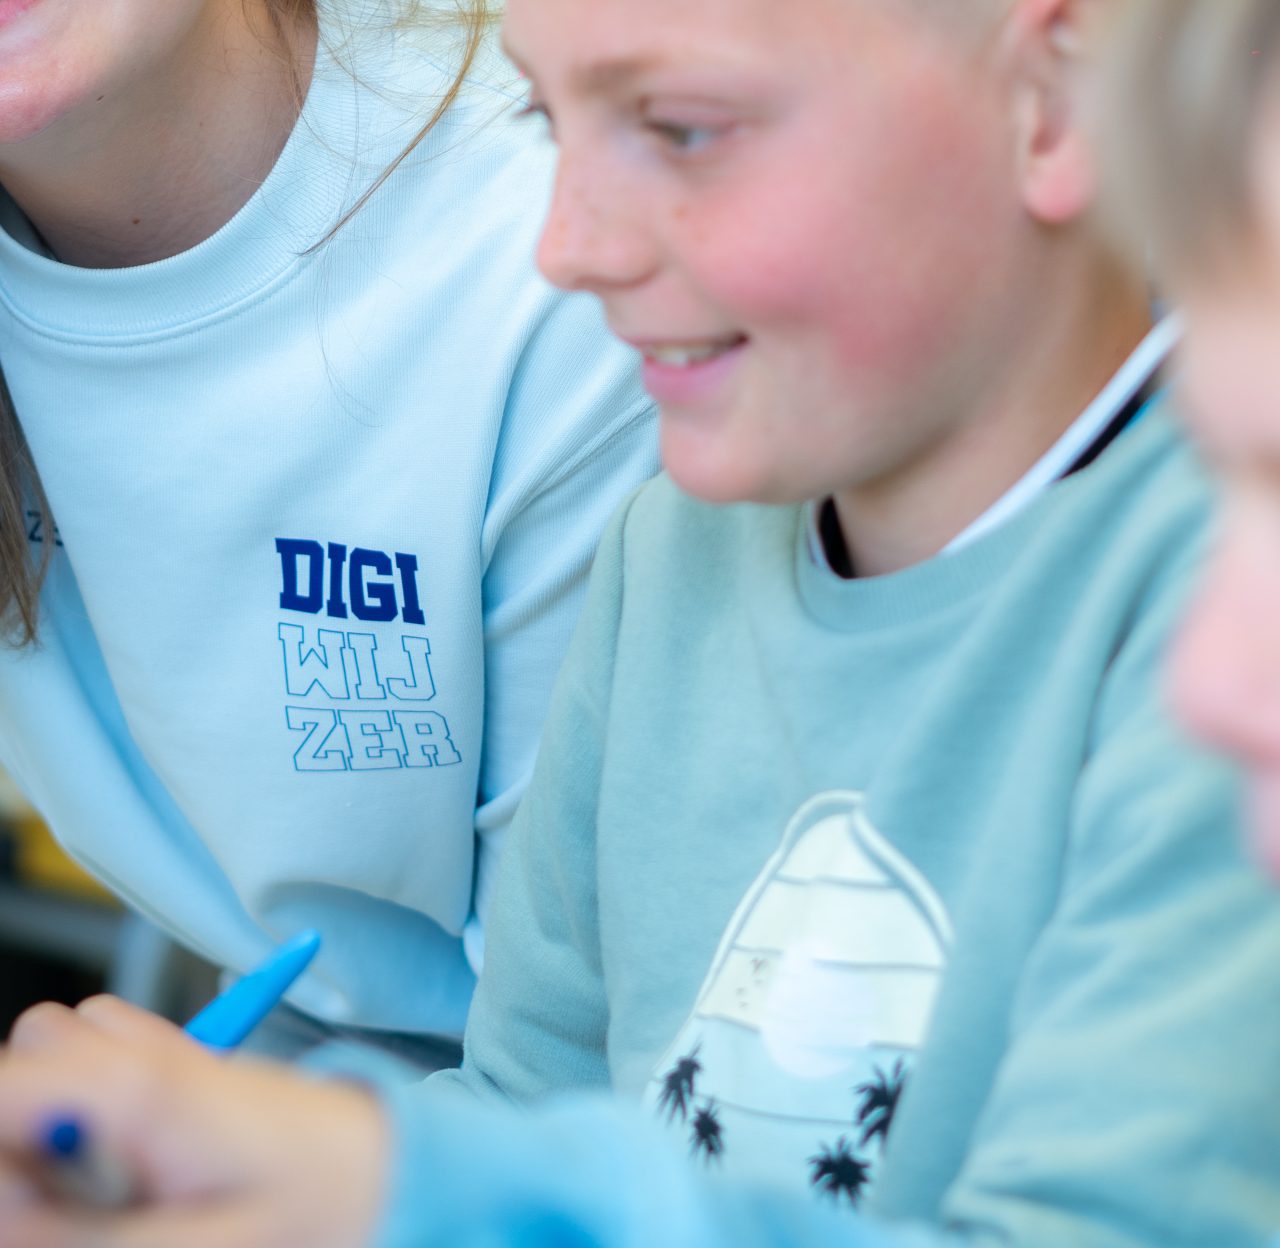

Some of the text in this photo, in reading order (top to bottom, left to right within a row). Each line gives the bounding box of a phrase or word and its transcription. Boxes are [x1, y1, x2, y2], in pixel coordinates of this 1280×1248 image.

[275, 537, 425, 625] DIGI
[278, 622, 436, 700] WIJ
[285, 705, 462, 771] ZER
